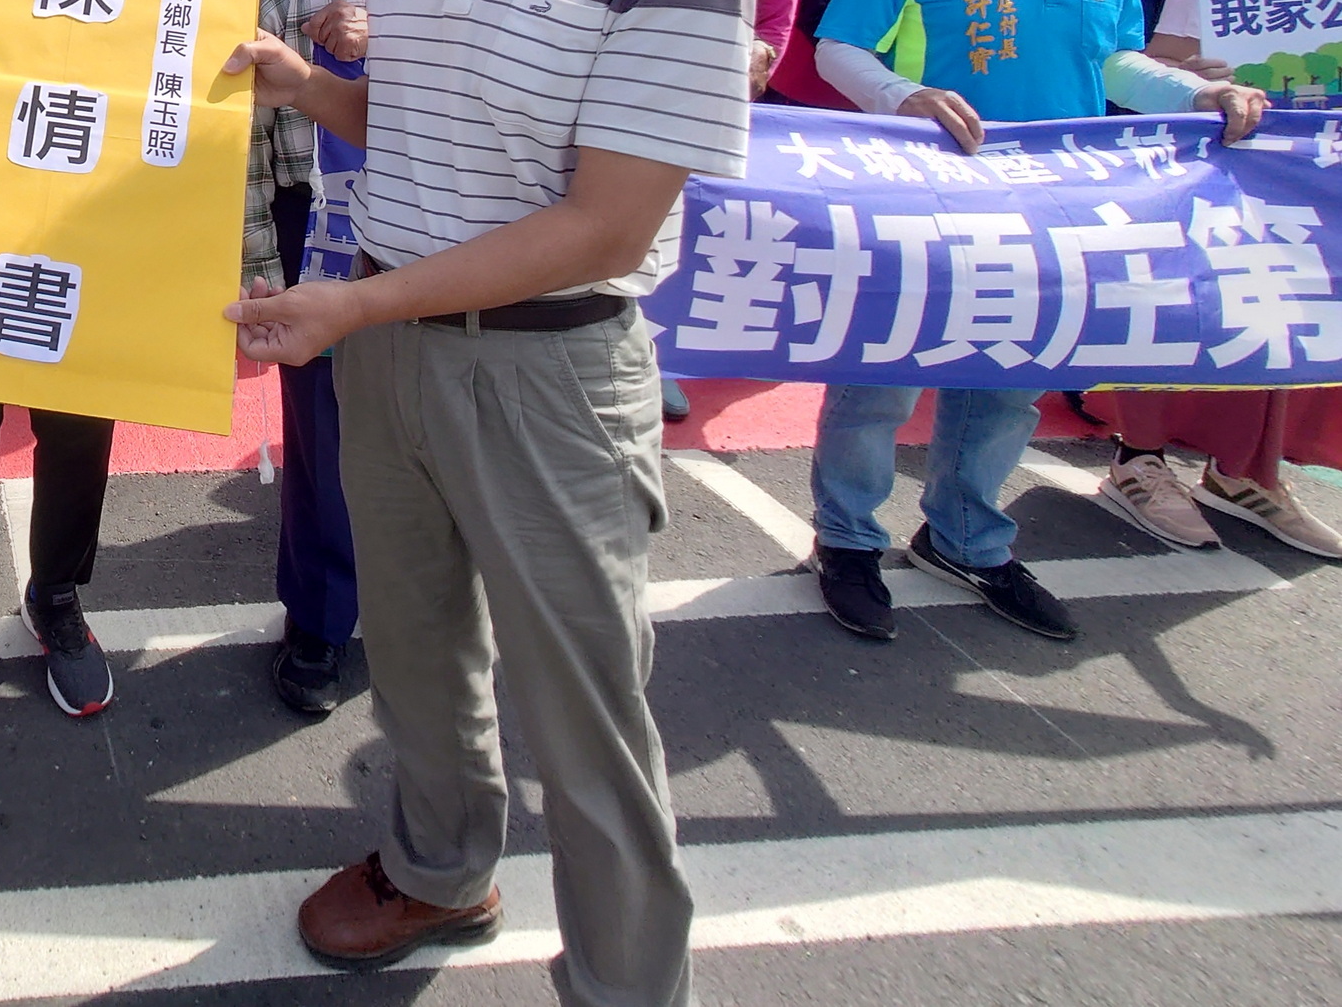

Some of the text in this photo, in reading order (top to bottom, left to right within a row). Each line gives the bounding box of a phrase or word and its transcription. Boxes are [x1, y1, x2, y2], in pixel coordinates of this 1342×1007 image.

[146, 71, 184, 160] 陳玉照
[648, 194, 1342, 371] 對頂庄第
